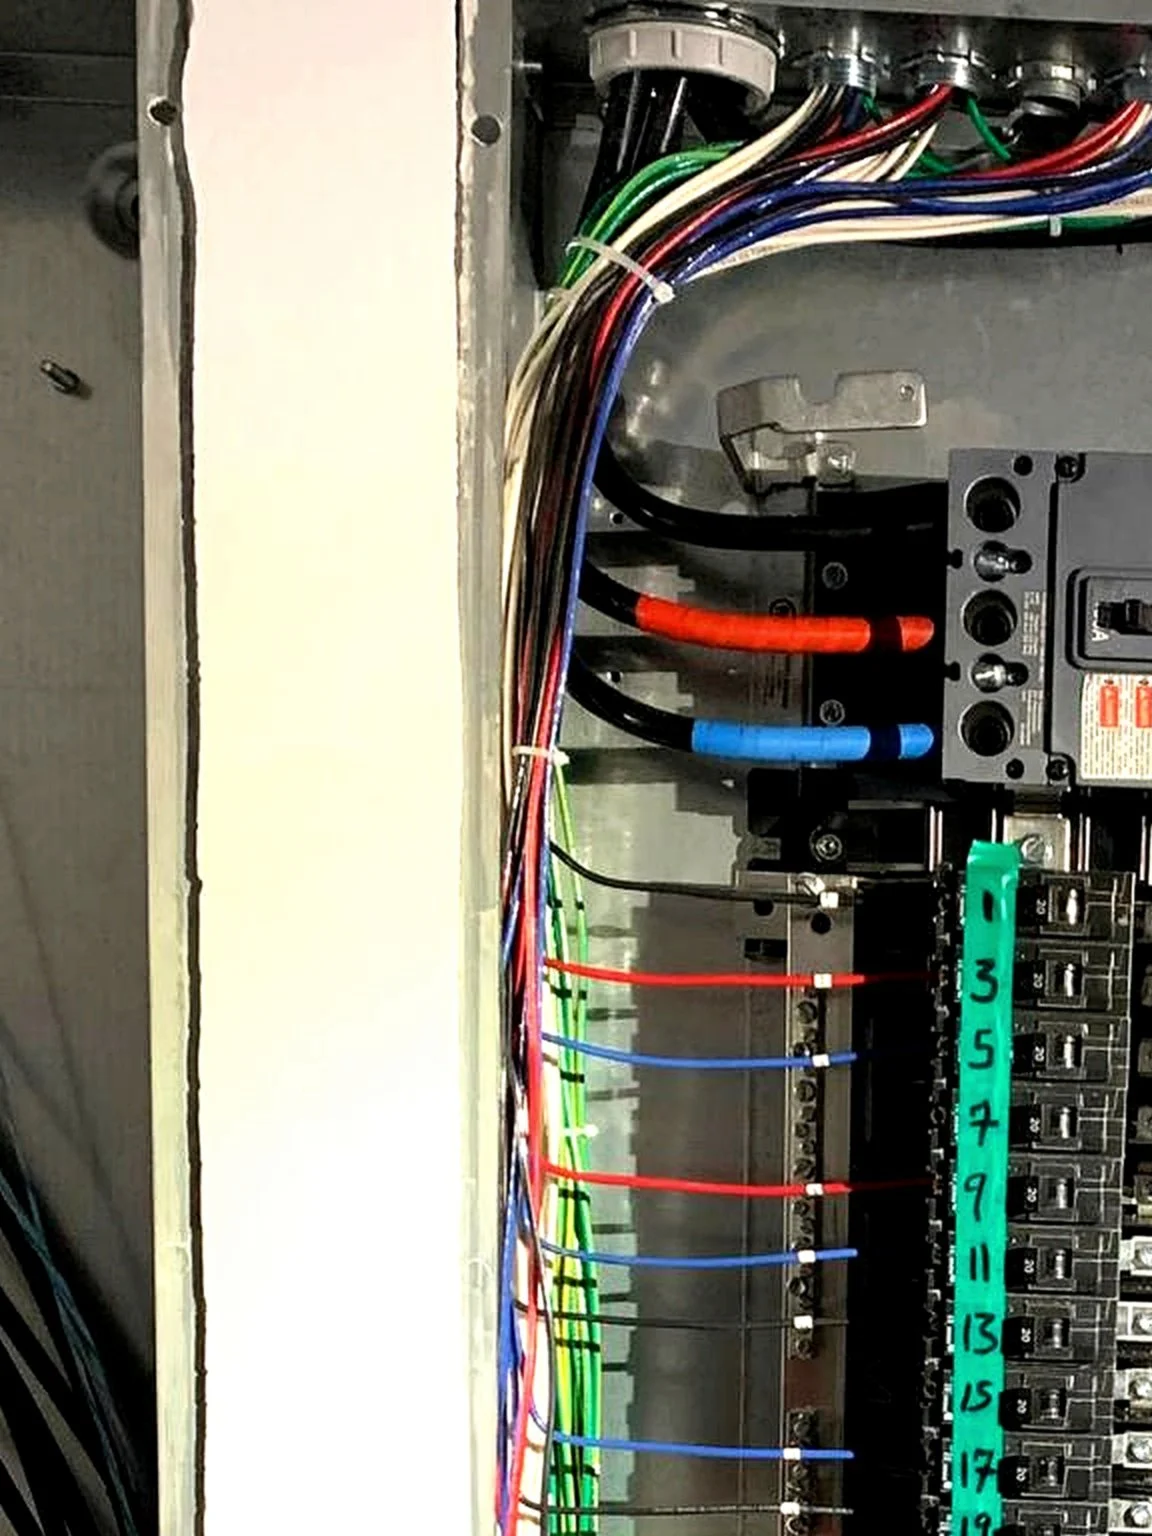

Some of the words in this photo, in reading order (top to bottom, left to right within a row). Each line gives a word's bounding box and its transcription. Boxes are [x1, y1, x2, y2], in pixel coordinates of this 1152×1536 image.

[983, 890, 994, 922] 1
[1036, 898, 1046, 915] 20
[971, 959, 998, 1003] 3
[1033, 973, 1043, 989] 20
[969, 1030, 994, 1069] 5
[1035, 1046, 1045, 1062] 20
[971, 1101, 998, 1146] 7
[1030, 1117, 1040, 1132] 20
[965, 1174, 987, 1222] 9
[1027, 1187, 1036, 1203] 20
[970, 1244, 989, 1281] 11
[1024, 1258, 1034, 1274] 20
[964, 1313, 998, 1354] 13
[1021, 1328, 1030, 1343] 20
[961, 1381, 991, 1412] 15
[1017, 1398, 1027, 1414] 20
[961, 1449, 998, 1492] 17
[1016, 1467, 1026, 1482] 20
